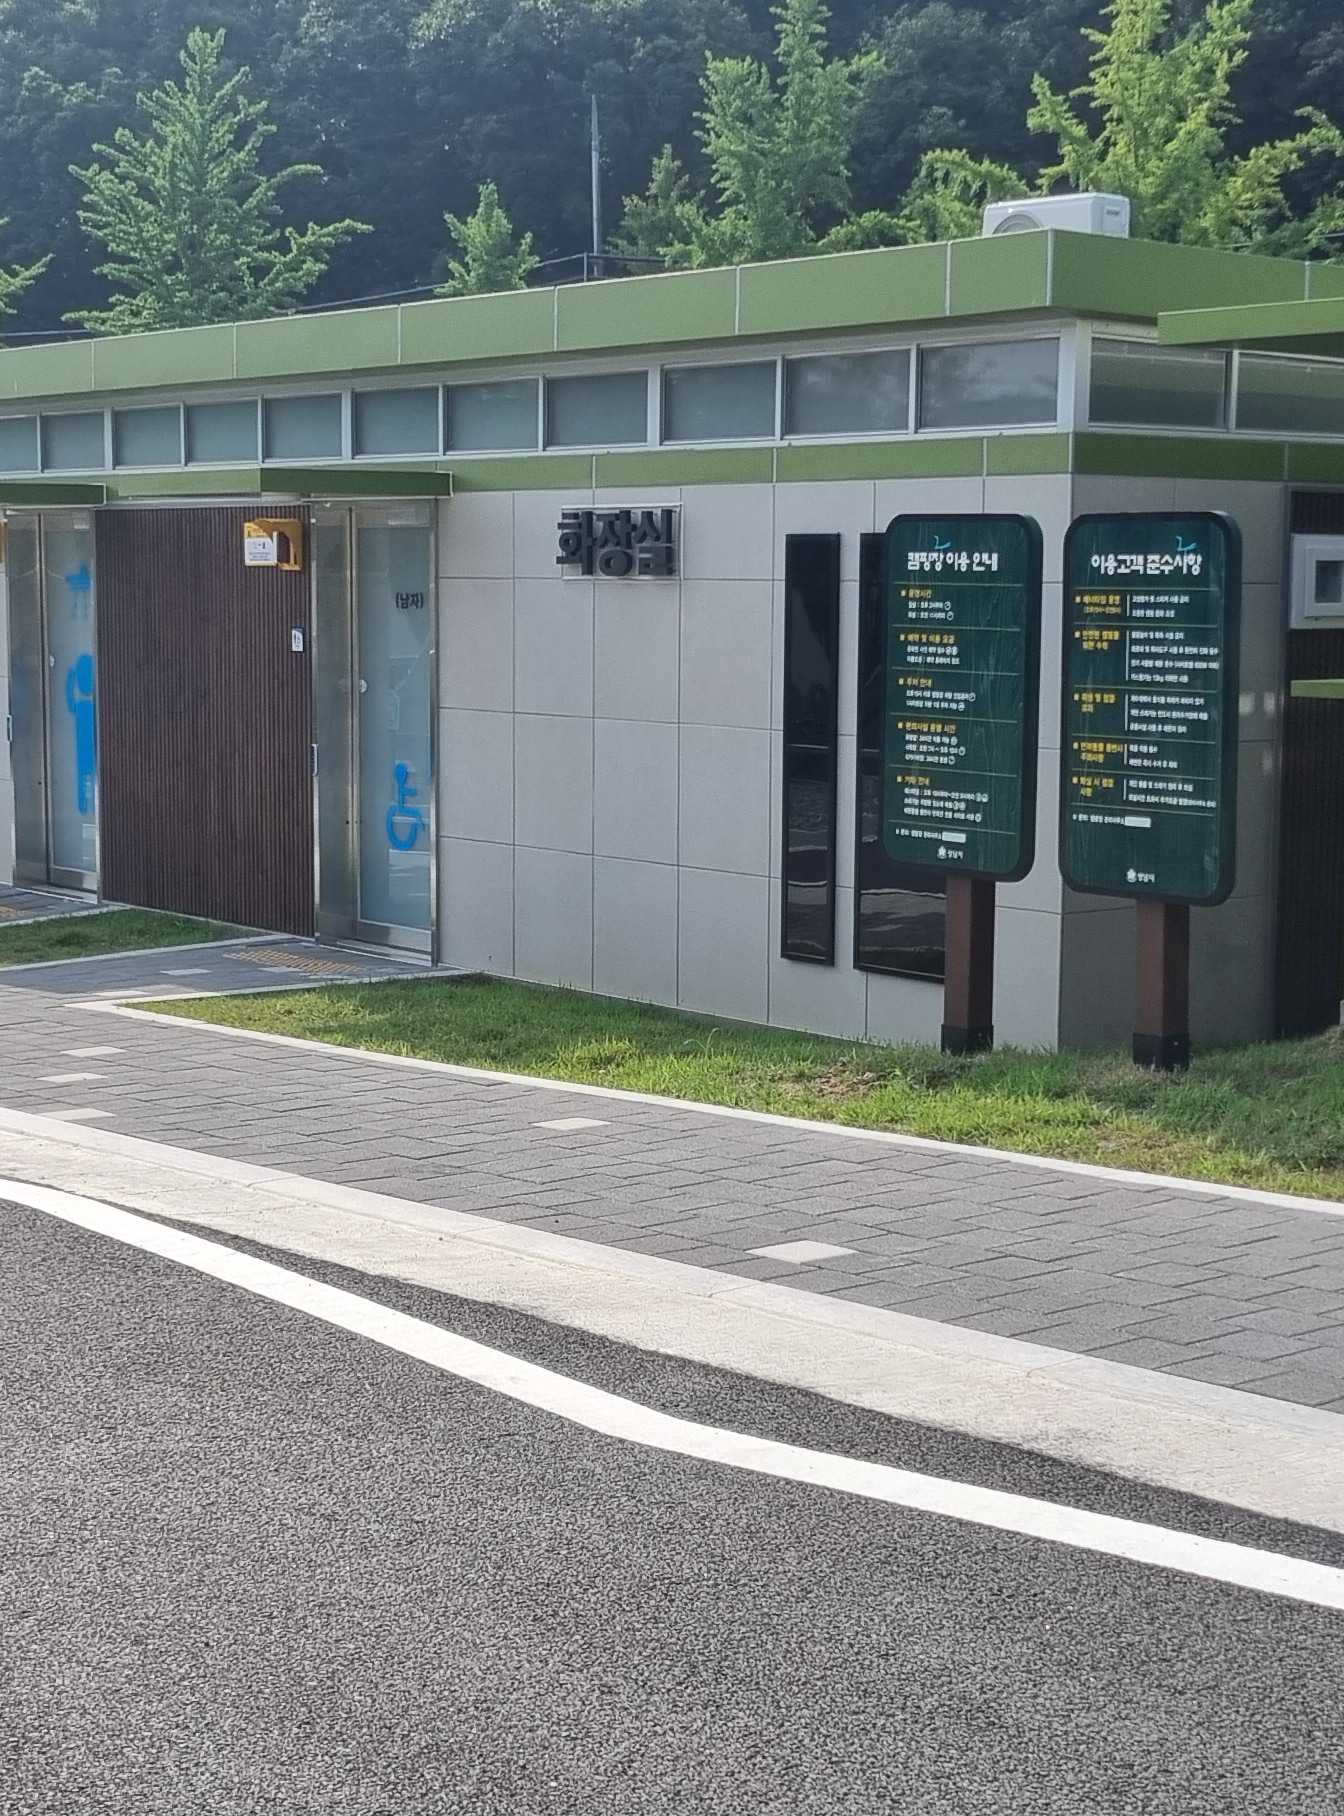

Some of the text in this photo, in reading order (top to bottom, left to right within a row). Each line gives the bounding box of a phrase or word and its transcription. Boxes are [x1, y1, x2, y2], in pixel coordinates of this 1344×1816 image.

[556, 509, 674, 577] 화장실
[907, 551, 999, 572] 캠핑장 이용 안내
[1091, 552, 1203, 576] 이용고객 준수사항
[396, 592, 423, 610] (남자)
